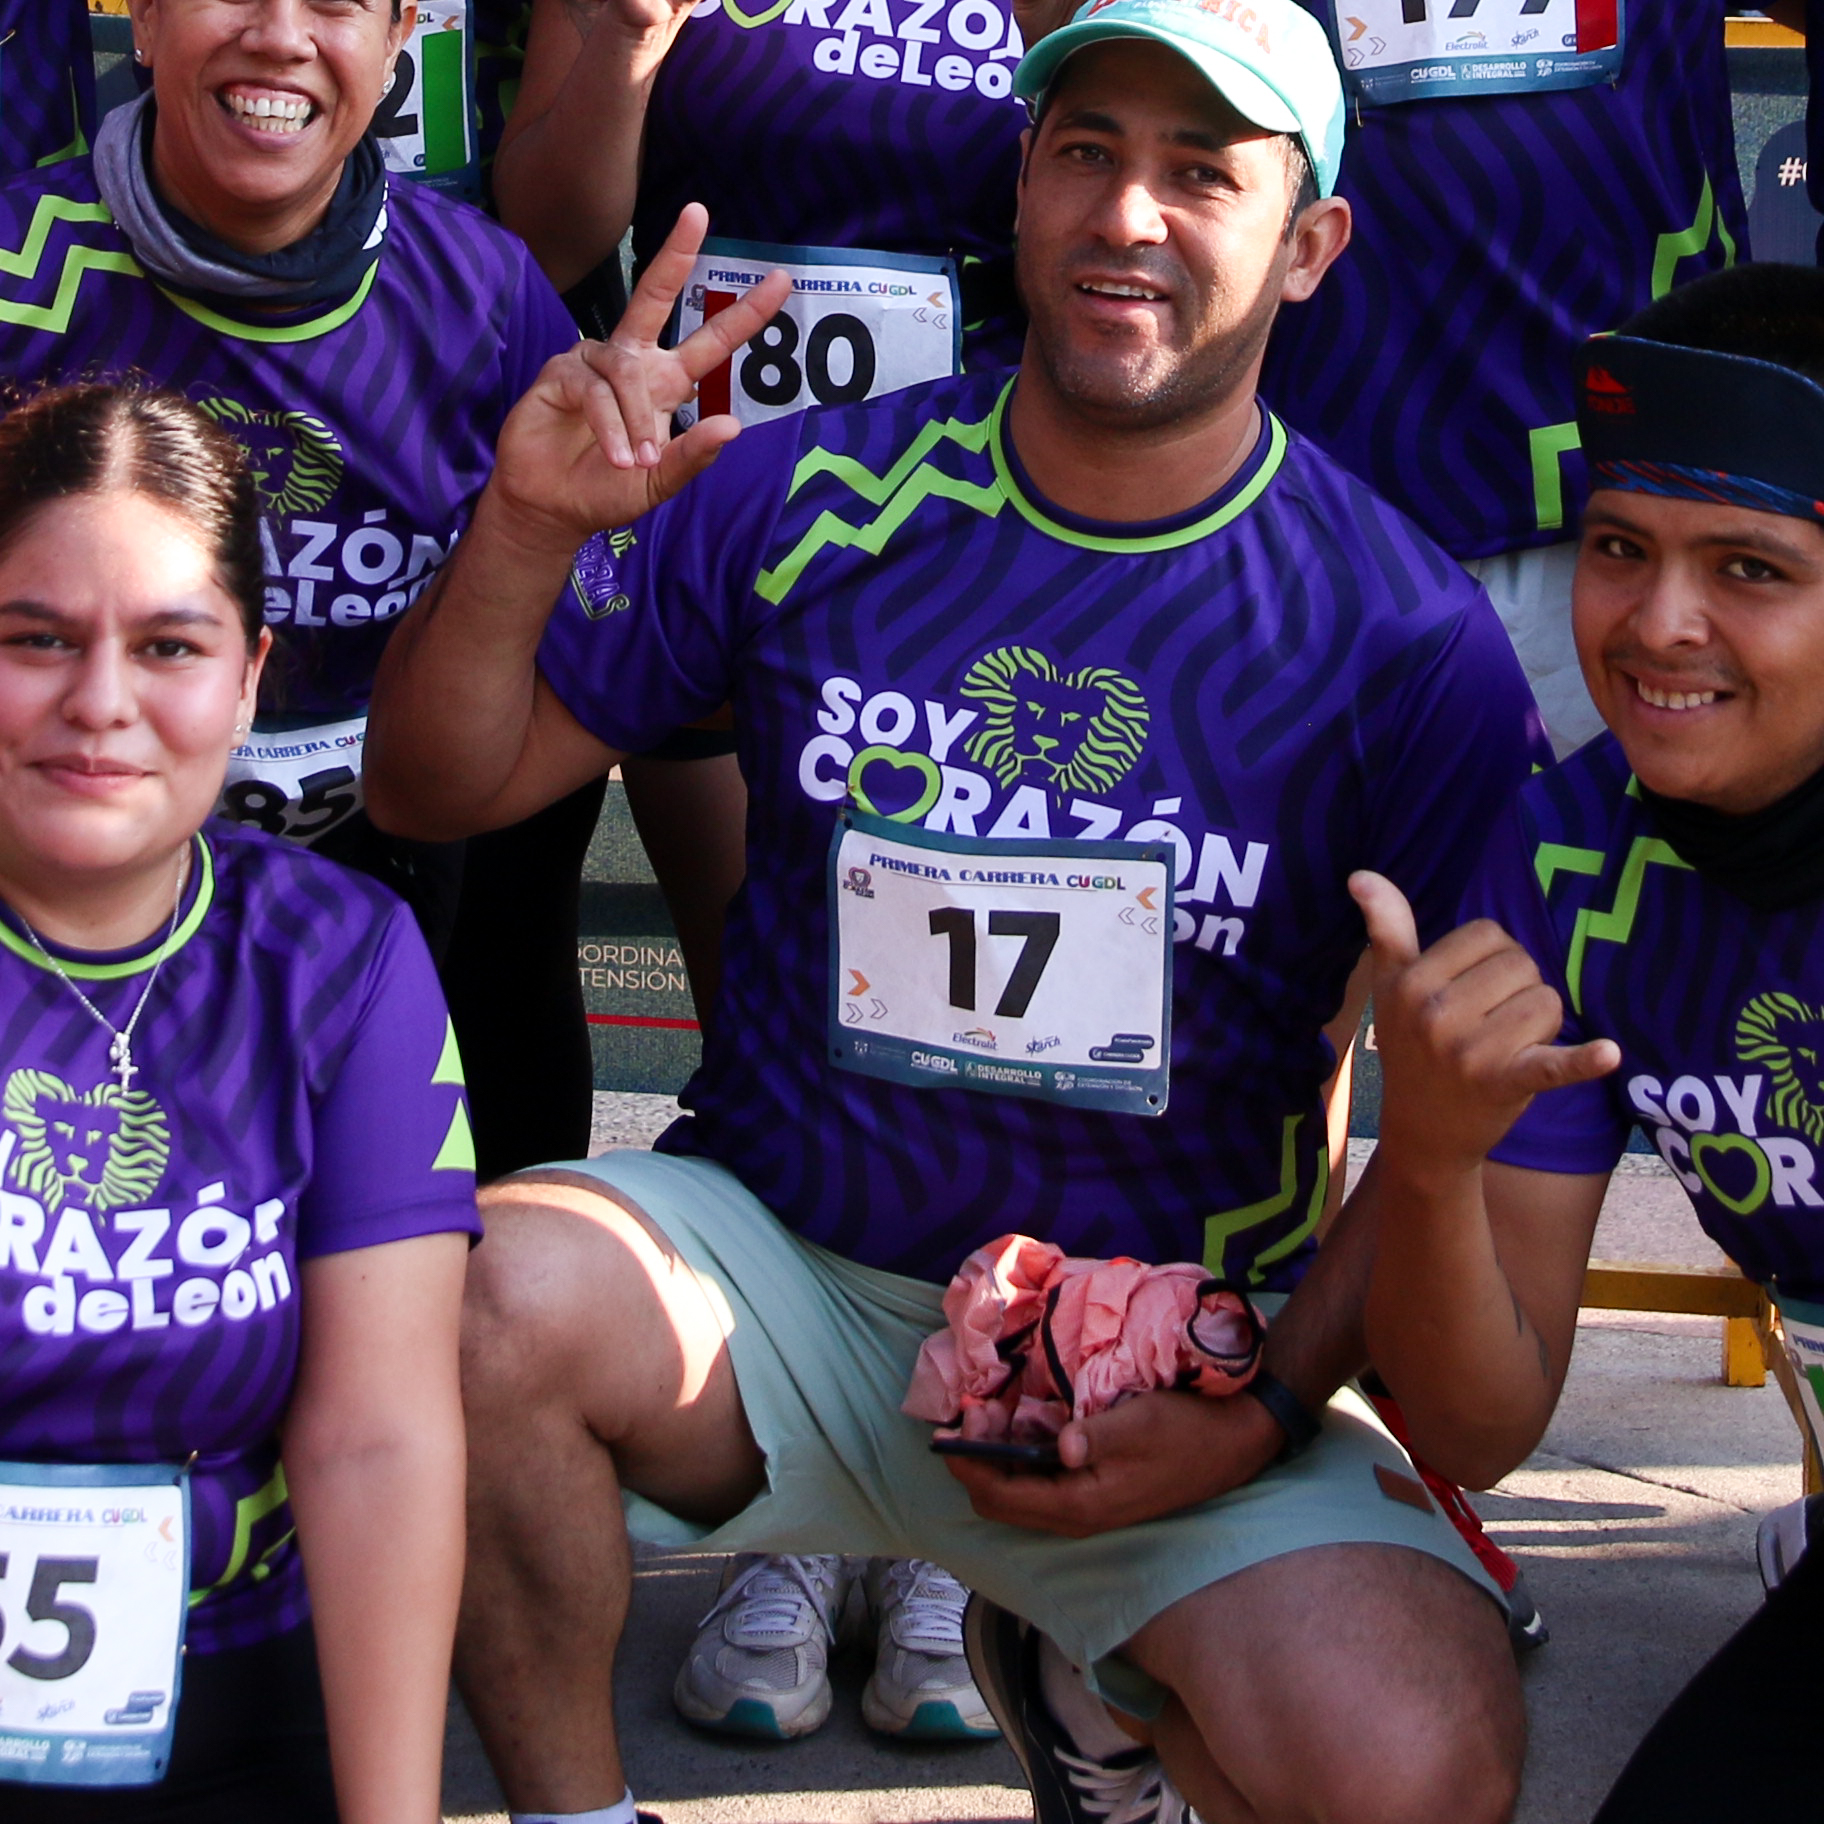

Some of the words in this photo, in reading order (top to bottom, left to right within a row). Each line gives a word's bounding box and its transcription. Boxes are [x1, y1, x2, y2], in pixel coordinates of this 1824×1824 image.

[813, 31, 1024, 105] deLeó
[868, 281, 918, 296] CUGDL
[739, 310, 876, 407] 80
[817, 676, 979, 764] SOY
[869, 853, 951, 881] PRIMERA
[959, 869, 1060, 886] CARRERA
[1066, 874, 1126, 890] CUGDL
[579, 968, 686, 992] TENSIÓN
[928, 906, 1061, 1019] 17
[1628, 1073, 1763, 1138] SOY
[23, 1251, 292, 1337] deLeón
